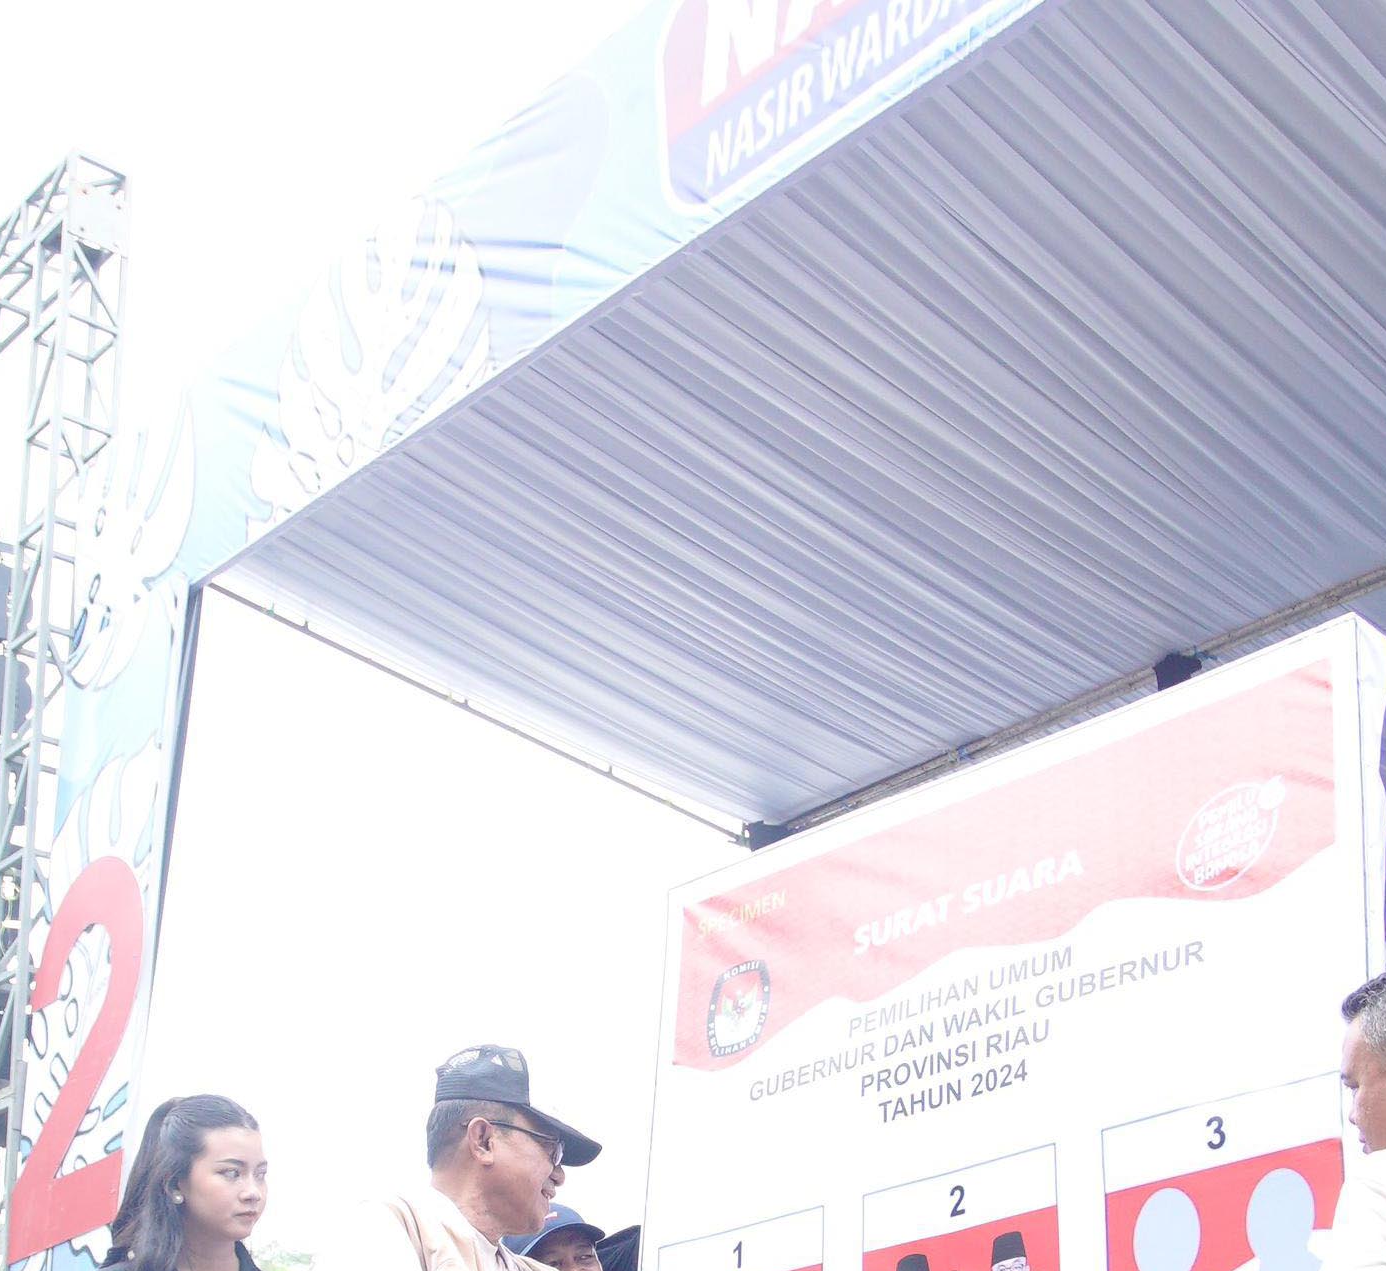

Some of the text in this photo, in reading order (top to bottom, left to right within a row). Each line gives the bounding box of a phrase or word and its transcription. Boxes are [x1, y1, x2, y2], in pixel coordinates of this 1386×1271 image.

[704, 63, 814, 188] NASIR
[698, 888, 788, 938] SPECIMEN
[852, 850, 1085, 957] SURAT SUARA
[749, 940, 1206, 1103] GUBERNUR DAN WAKIL GUBERNUR
[848, 945, 1073, 1038] PEMILIHAN UMUM
[860, 1018, 1051, 1098] PROVINSI RIAU
[877, 1059, 1029, 1125] TAHUN 2024
[1206, 1115, 1227, 1150] 3
[949, 1185, 966, 1218] 2
[732, 1240, 743, 1270] 1
